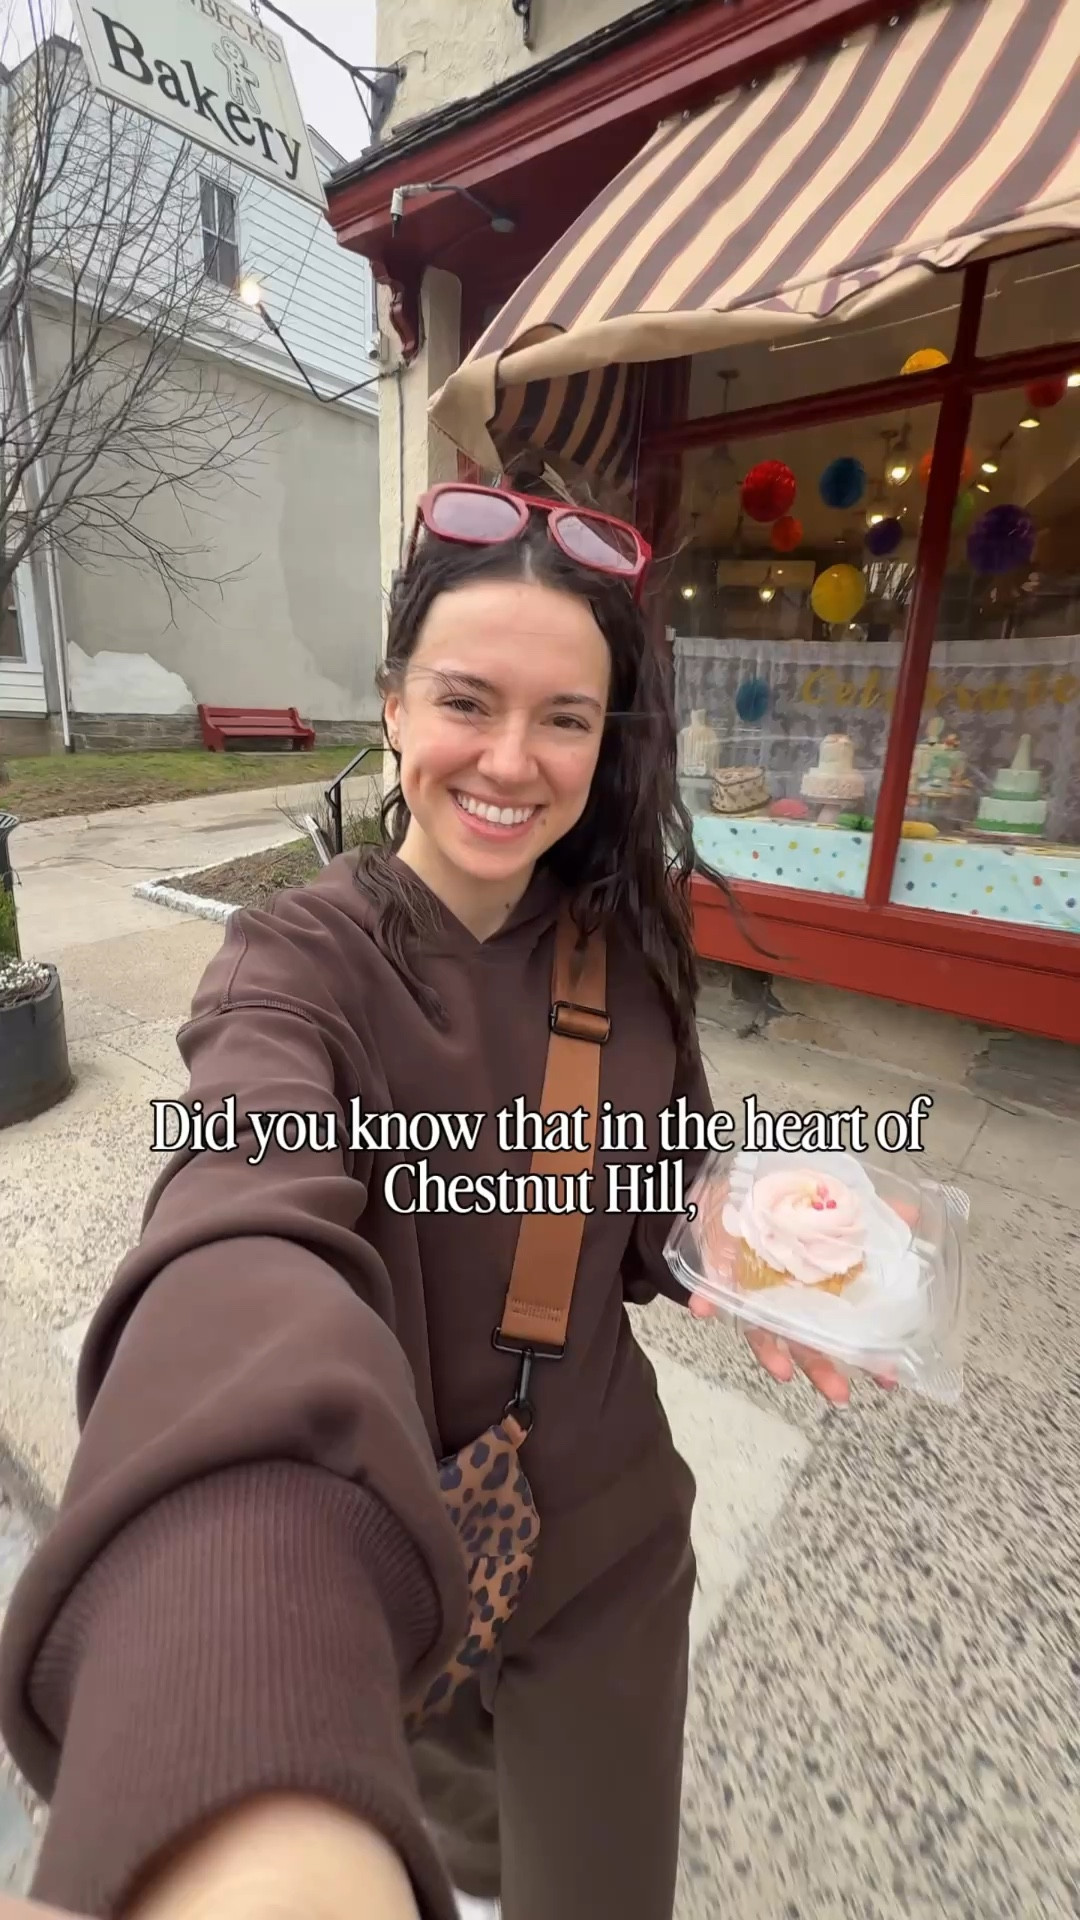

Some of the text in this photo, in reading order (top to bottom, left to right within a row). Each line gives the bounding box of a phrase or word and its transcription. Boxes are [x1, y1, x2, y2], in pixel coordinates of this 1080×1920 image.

[190, 0, 282, 63] BECK'S
[92, 7, 301, 181] Bakery
[801, 665, 1079, 713] Celbrate
